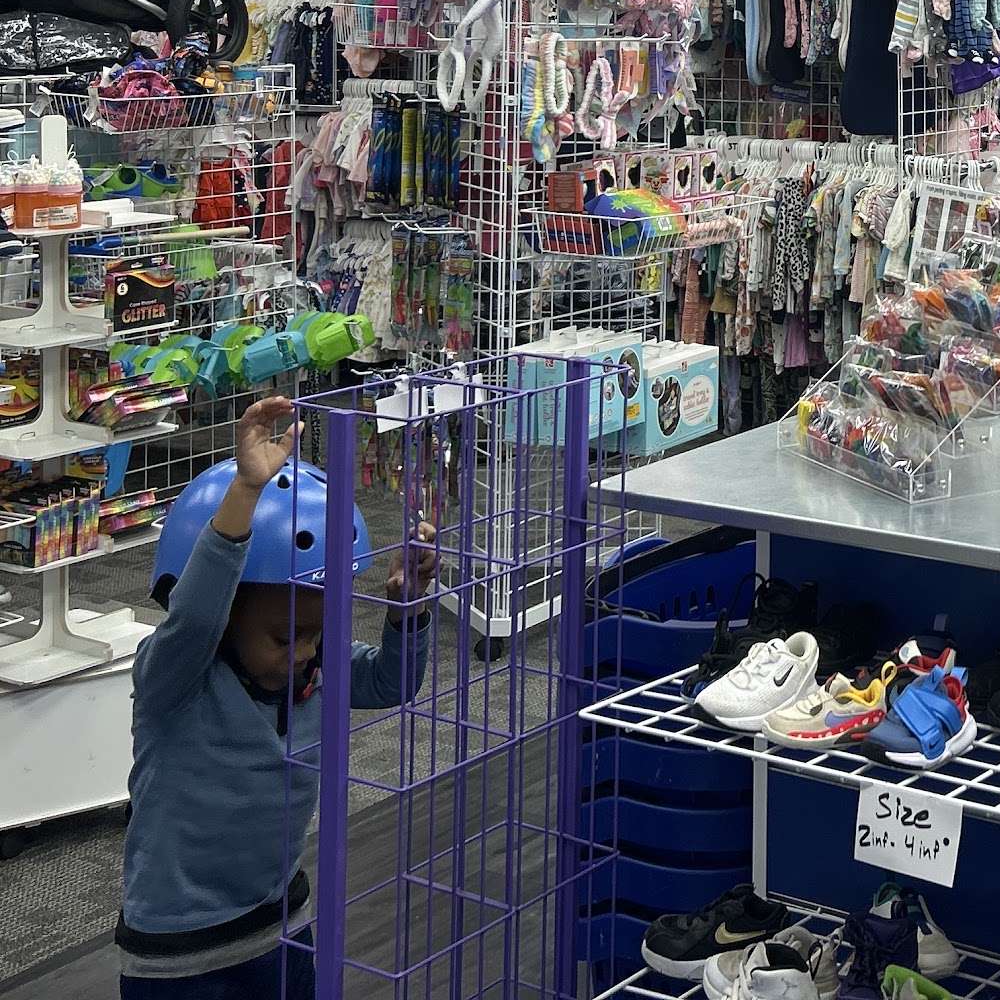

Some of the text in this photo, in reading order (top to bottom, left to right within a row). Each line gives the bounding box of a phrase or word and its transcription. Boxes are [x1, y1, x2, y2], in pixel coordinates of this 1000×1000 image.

[728, 142, 738, 151] 3T
[121, 303, 166, 324] GLITTER
[875, 792, 932, 829] Size
